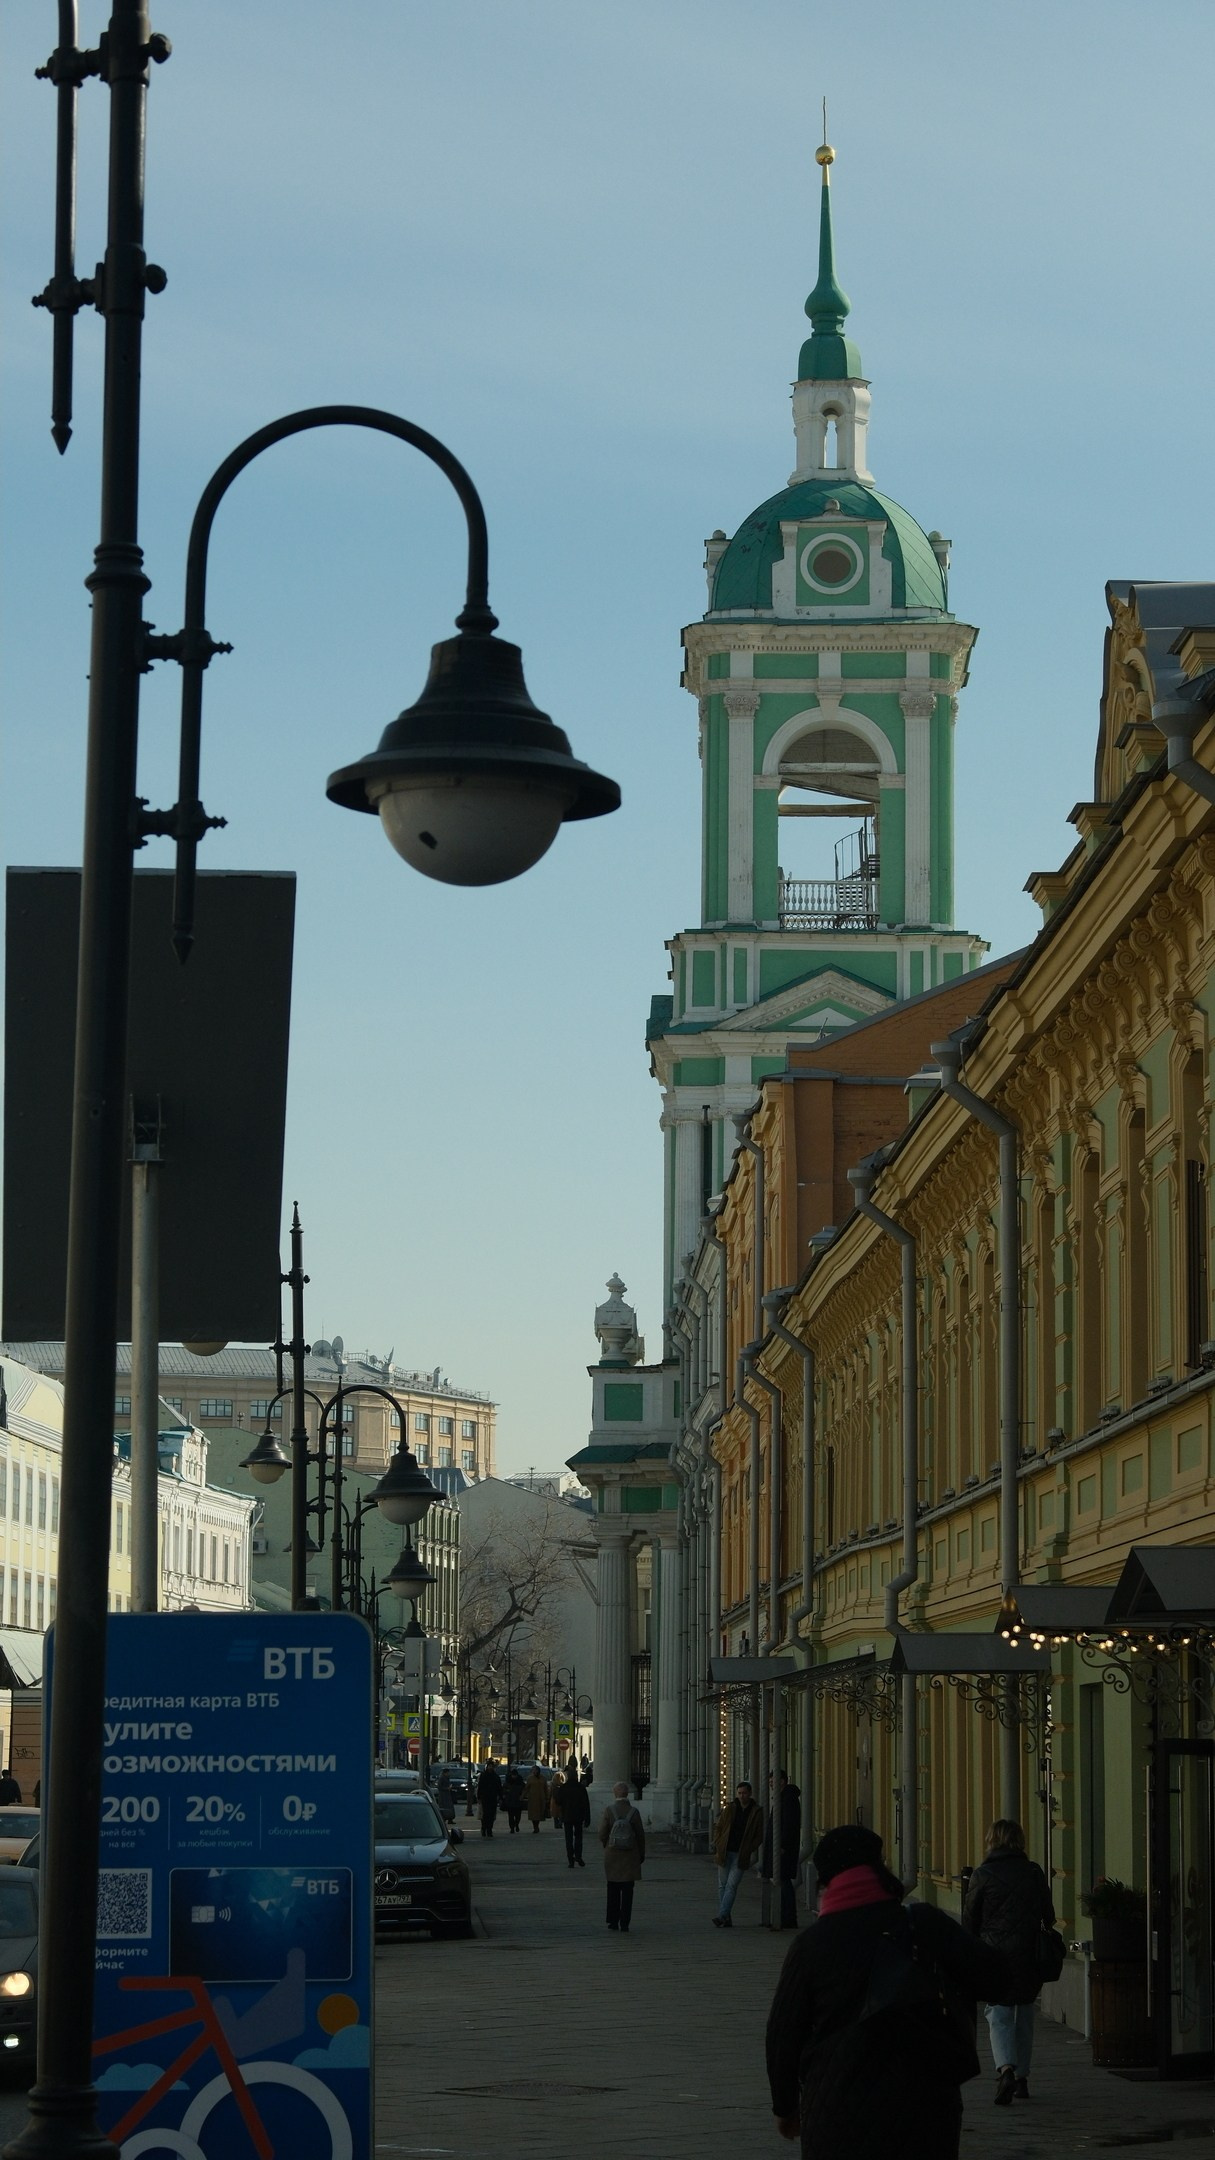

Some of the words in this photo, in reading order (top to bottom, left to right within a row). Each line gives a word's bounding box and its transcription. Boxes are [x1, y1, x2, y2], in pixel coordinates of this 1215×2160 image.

[264, 1647, 335, 1680] ВТБ
[191, 1697, 241, 1711] карта
[247, 1693, 280, 1707] ВТБ
[104, 1722, 193, 1746] улите
[103, 1754, 337, 1773] озможностями
[101, 1796, 160, 1823] 200
[185, 1795, 246, 1822] 20%
[268, 1827, 331, 1838] обслуживание
[217, 1841, 253, 1850] покупки
[307, 1880, 340, 1895] ВТБ
[95, 1946, 148, 1959] формите
[95, 1960, 126, 1970] йчас
